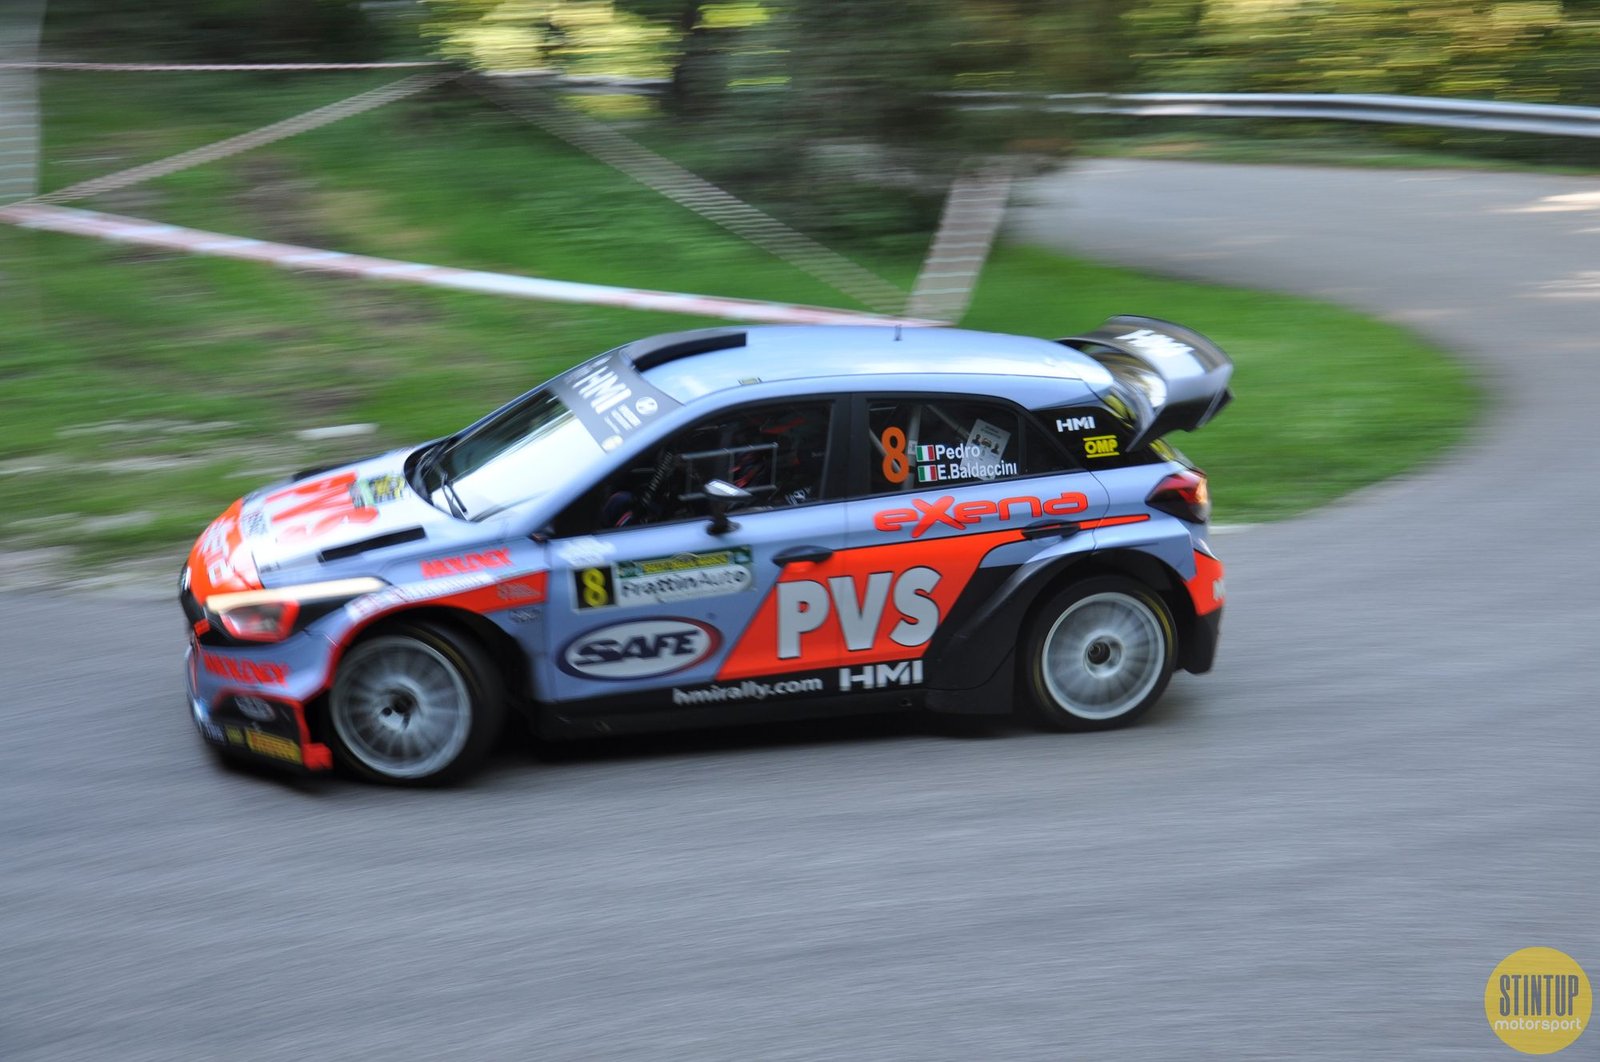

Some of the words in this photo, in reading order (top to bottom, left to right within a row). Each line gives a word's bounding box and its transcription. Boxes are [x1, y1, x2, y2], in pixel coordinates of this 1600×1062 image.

[1056, 415, 1096, 432] HMI
[881, 426, 909, 484] 8
[935, 442, 981, 463] Pedro
[1084, 438, 1119, 455] OMP
[938, 459, 1018, 481] E.Baldaccini
[581, 567, 609, 609] 8
[776, 565, 944, 660] PVS
[574, 628, 701, 667] SAFE
[839, 660, 924, 691] HMI
[672, 676, 824, 706] hmirally.com
